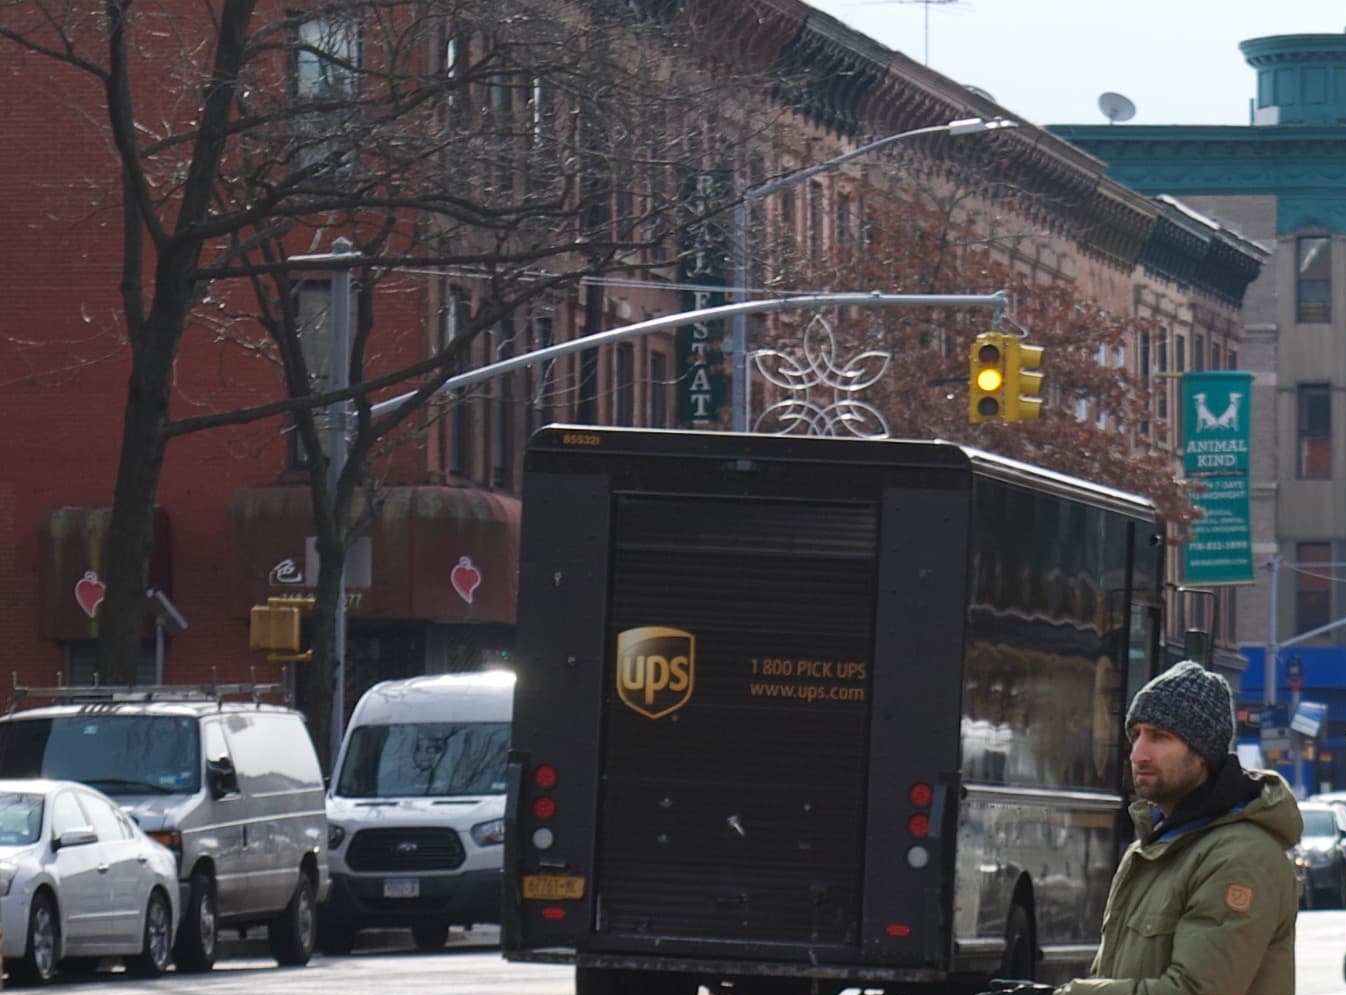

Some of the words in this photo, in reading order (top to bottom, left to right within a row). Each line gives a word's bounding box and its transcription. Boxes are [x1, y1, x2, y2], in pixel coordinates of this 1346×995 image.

[690, 292, 711, 424] ESTAT
[1186, 440, 1248, 453] ANIMAL
[1197, 454, 1236, 467] KIND
[751, 658, 758, 674] 1
[763, 658, 792, 676] 800
[797, 660, 833, 678] PICK
[837, 662, 865, 680] UPS
[623, 655, 688, 704] ups
[750, 683, 865, 702] www.ups.com
